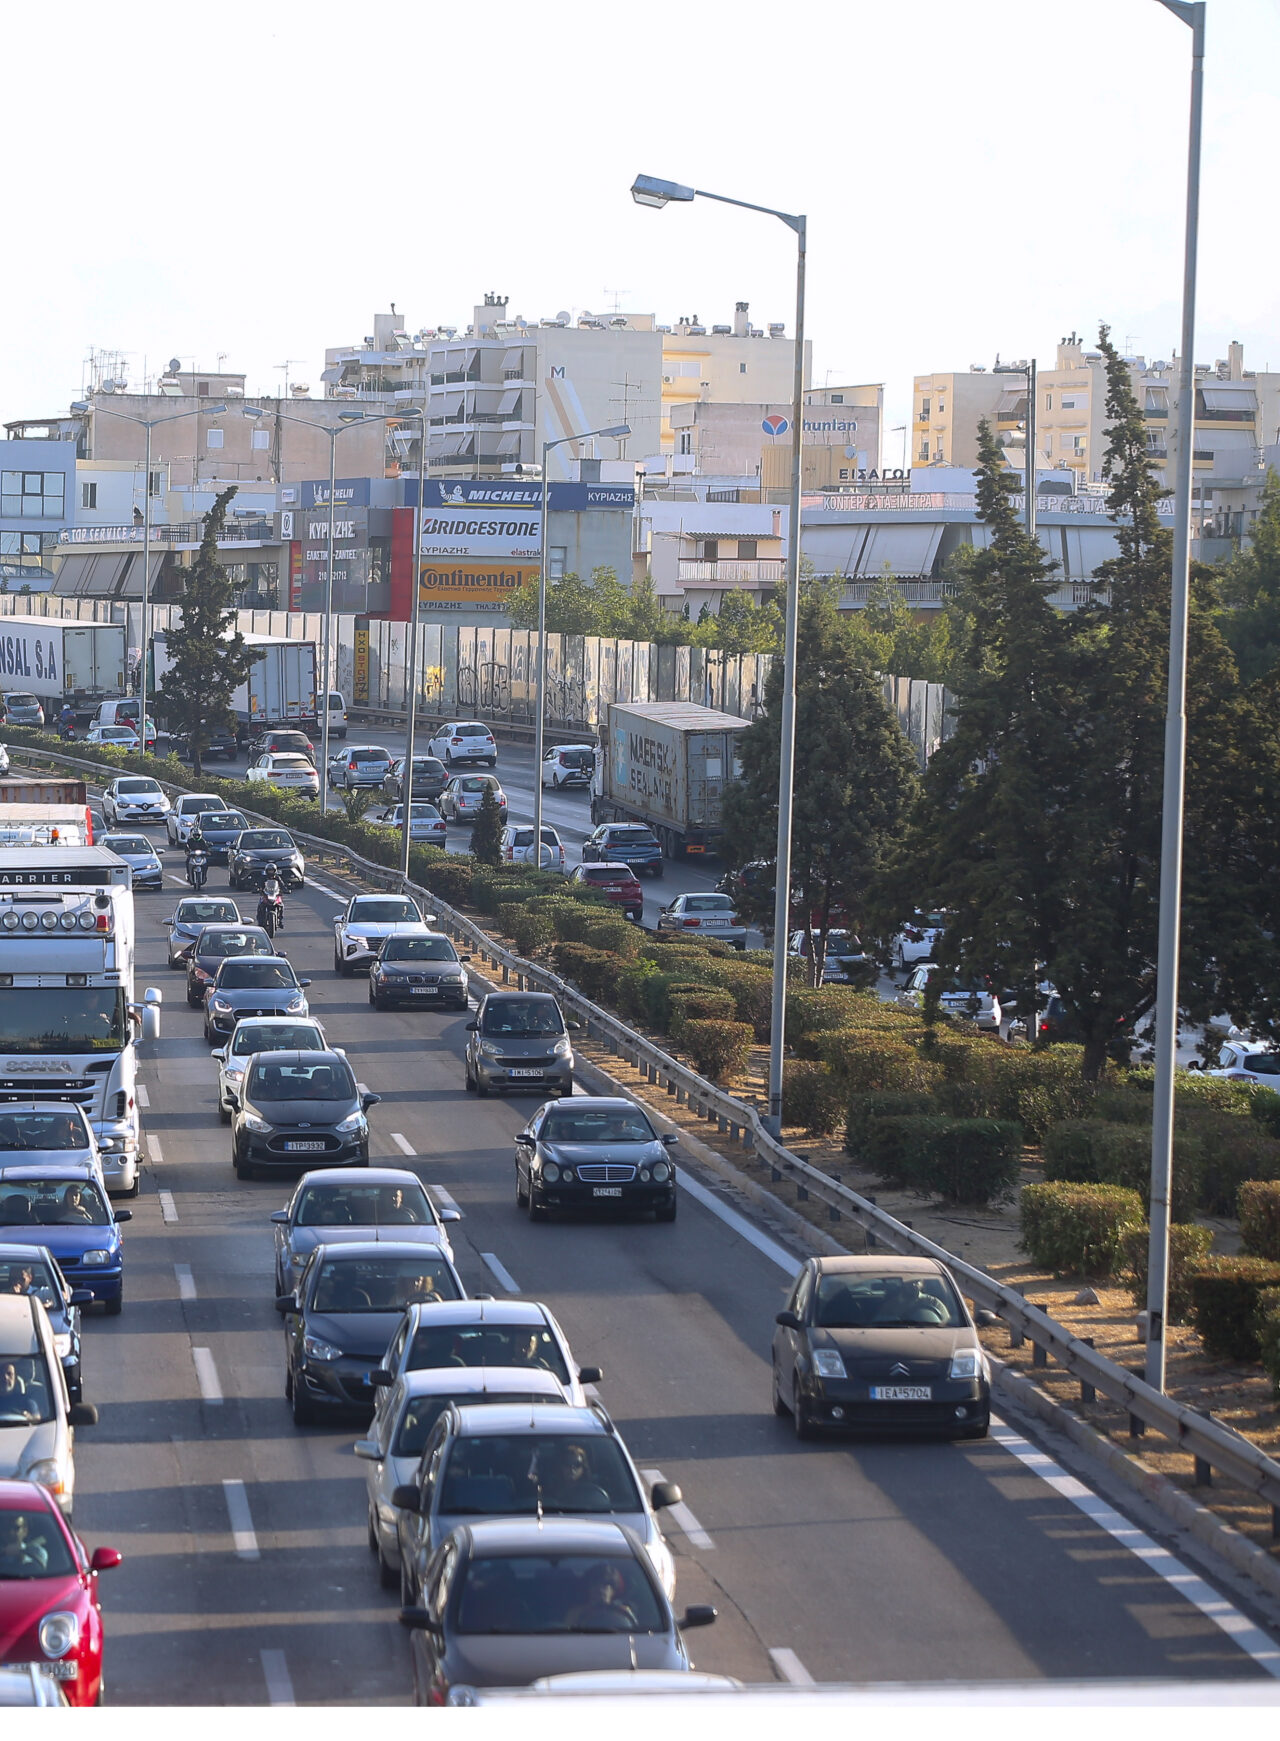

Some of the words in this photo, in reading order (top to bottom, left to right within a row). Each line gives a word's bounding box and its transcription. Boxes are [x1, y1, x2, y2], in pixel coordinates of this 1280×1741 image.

[791, 419, 857, 431] hunlan
[323, 487, 354, 499] MCHELIN
[588, 492, 633, 502] ΚΥΡΙΑΖΗΣ
[89, 527, 127, 541] SERVICE
[422, 518, 540, 537] BRIDGESTONE
[420, 568, 522, 590] Continental
